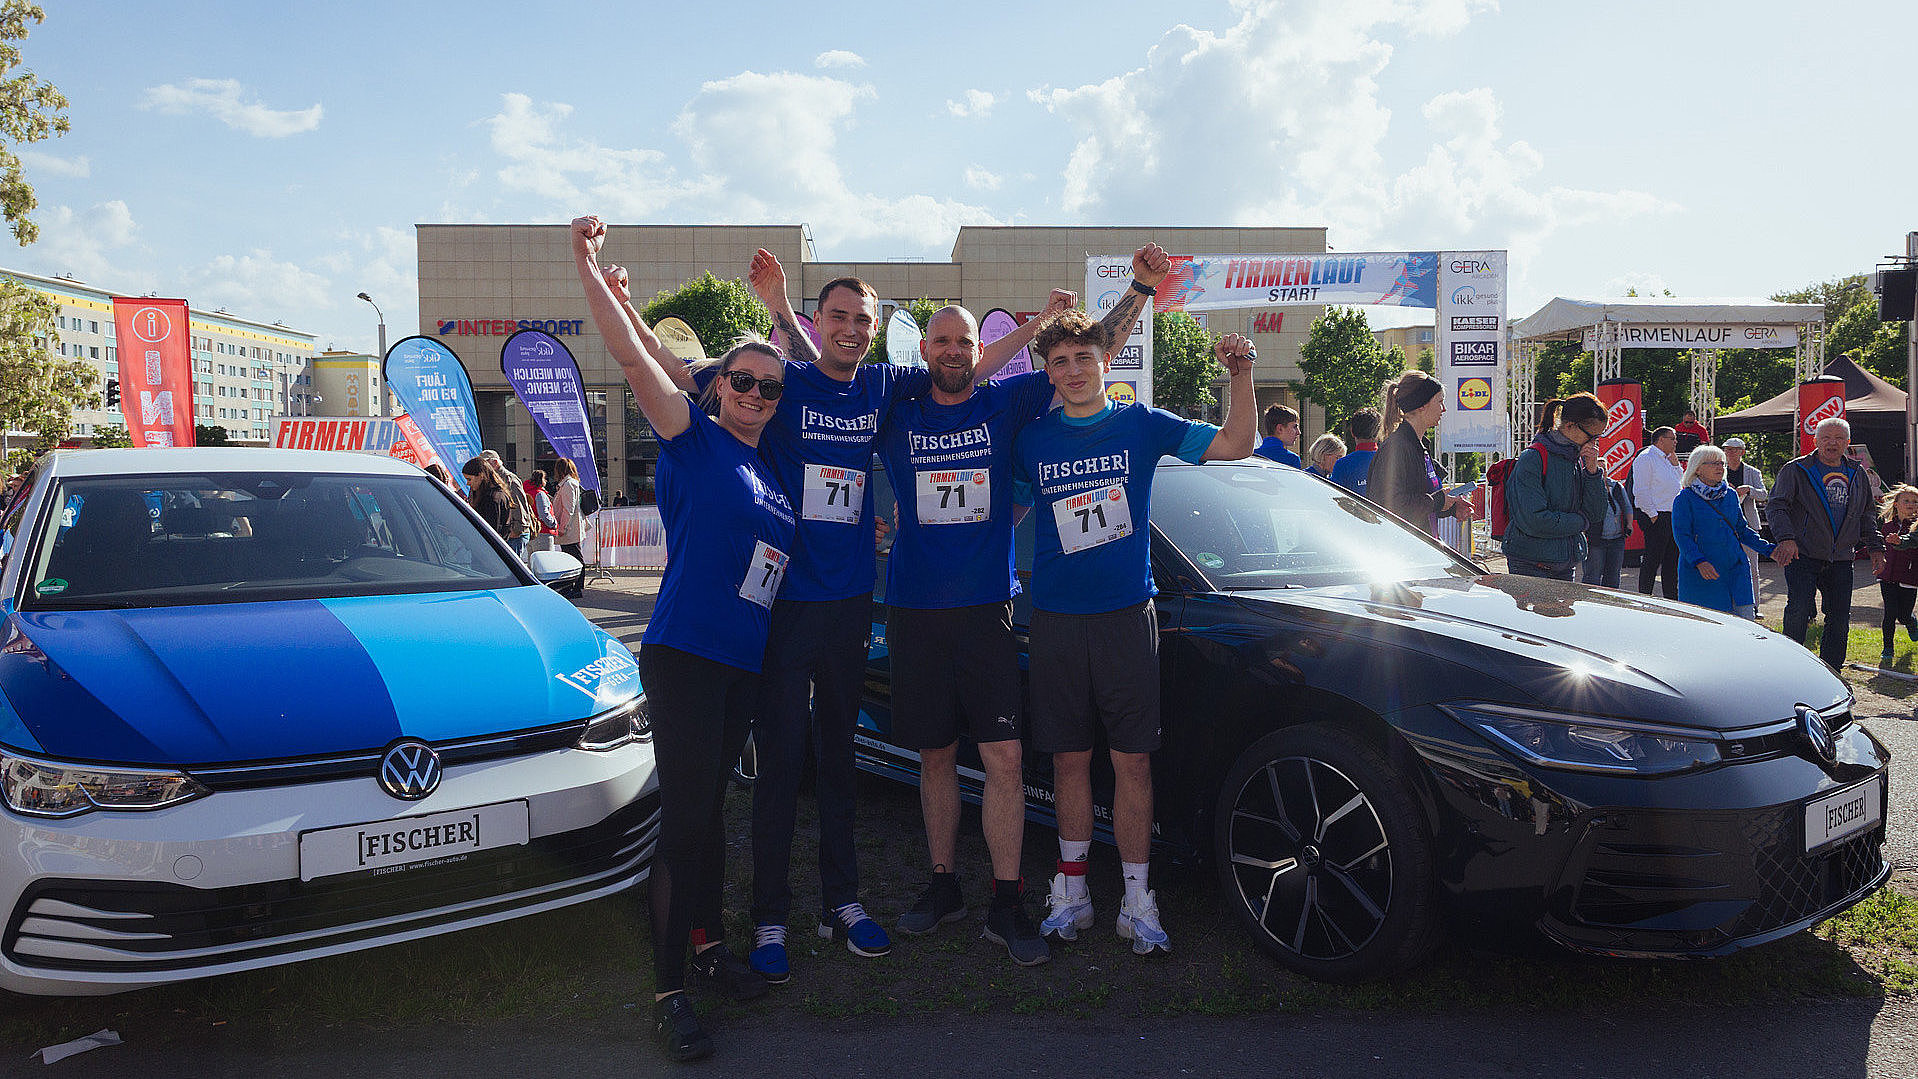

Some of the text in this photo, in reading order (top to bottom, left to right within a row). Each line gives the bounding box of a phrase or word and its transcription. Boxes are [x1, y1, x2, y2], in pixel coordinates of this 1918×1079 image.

[1225, 258, 1367, 288] FIRMENLAUF
[1450, 260, 1492, 273] GERA
[1268, 287, 1321, 302] START
[1456, 294, 1474, 305] ikk
[457, 319, 584, 336] INTERSPORT
[1253, 312, 1284, 333] H&M
[1452, 317, 1497, 325] KAESER
[1743, 327, 1779, 339] GERA
[1454, 343, 1495, 354] BIKAR
[1461, 388, 1489, 399] LIDL
[801, 405, 879, 432] [FISCHER]
[908, 423, 991, 455] [FISCHER]
[910, 447, 992, 464] UNTERNEHMENSGRUPPE
[819, 467, 858, 482] FIRMENLAUF
[929, 471, 974, 483] FIRMENLAUF
[1038, 450, 1129, 486] [FISCHER]
[825, 482, 850, 507] 71
[936, 484, 966, 508] 71
[1041, 476, 1129, 495] UNTERNEHMENSGRUPPE
[1066, 488, 1109, 511] FIRMENLAUF
[1073, 504, 1107, 533] 71
[761, 562, 779, 592] 71
[1825, 789, 1867, 838] [FISCHER]
[358, 813, 480, 866] [FISCHER]
[373, 854, 468, 877] [FISCHER] www.fischer-auto.de
